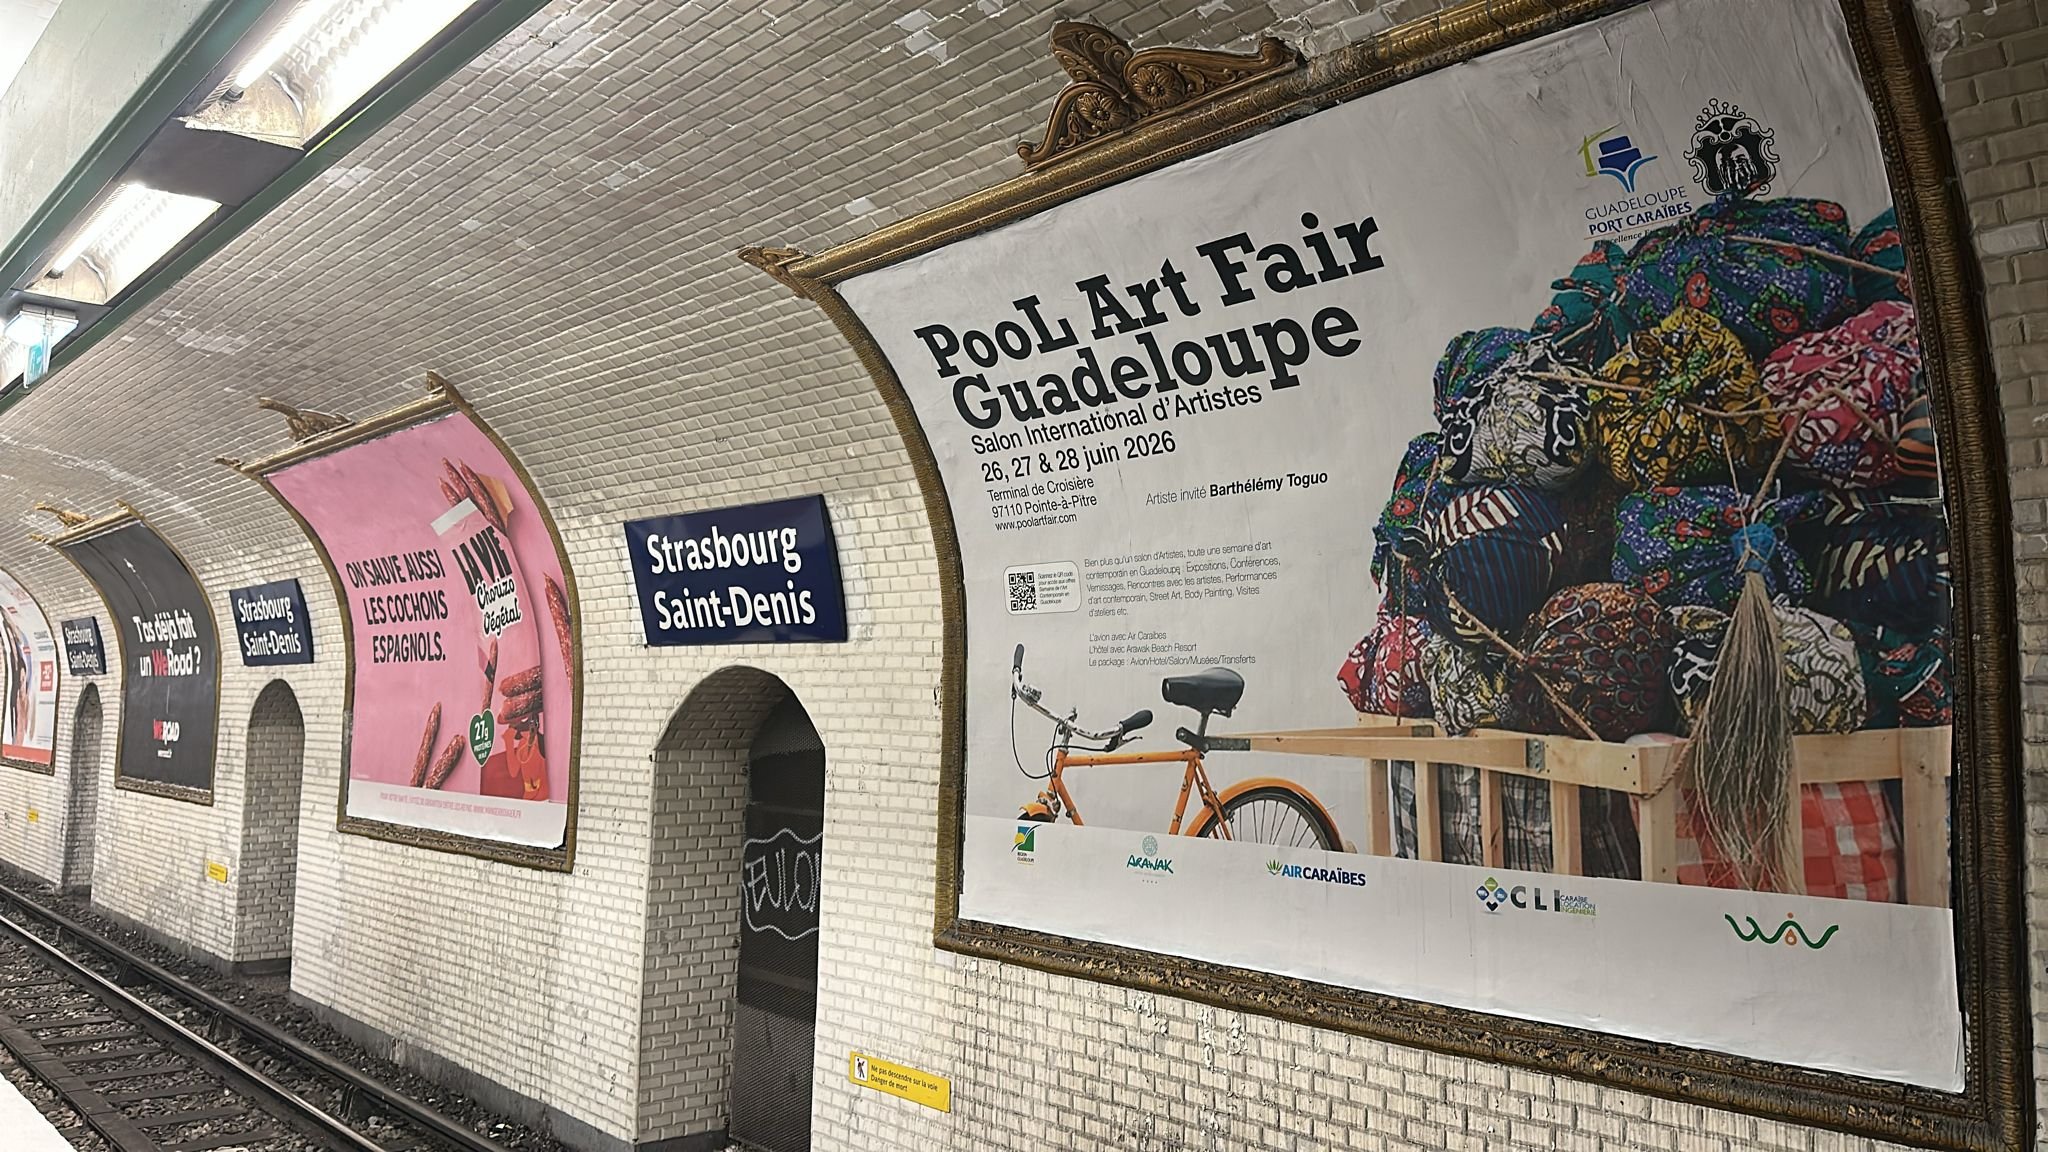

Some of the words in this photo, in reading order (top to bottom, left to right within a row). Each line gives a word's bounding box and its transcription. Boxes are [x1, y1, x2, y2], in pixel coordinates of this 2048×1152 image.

[1585, 186, 1687, 220] GUADELOUPE
[1588, 218, 1623, 235] PORT
[1626, 201, 1693, 226] CARAÏBES
[1611, 232, 1642, 244] cellence
[913, 294, 1080, 379] PooL
[1075, 257, 1201, 340] Art
[1195, 211, 1385, 307] Fair
[952, 306, 1362, 430] Guadeloupe
[971, 432, 1023, 455] Salon
[1024, 403, 1148, 446] International
[981, 461, 1009, 483] 26,
[1011, 455, 1033, 478] 27
[1039, 453, 1054, 474] &
[1055, 449, 1080, 470] 28
[1082, 442, 1120, 472] juin
[1124, 430, 1176, 460] 2026
[987, 484, 1030, 502] Terminal
[1031, 483, 1045, 496] de
[1046, 476, 1094, 494] Croisière
[1146, 489, 1177, 506] Artiste
[1180, 485, 1207, 501] invité
[1209, 477, 1284, 497] Barthélémy
[1286, 472, 1328, 489] Toguo
[991, 502, 1023, 518] 97110
[1024, 494, 1098, 514] Pointe-à-Pitre
[995, 513, 1078, 531] www.poolartfair.com
[646, 525, 802, 574] Strasbourg
[1100, 557, 1113, 566] plus
[1134, 552, 1152, 562] salon
[1187, 548, 1205, 557] toute
[1207, 547, 1221, 555] une
[1222, 544, 1253, 554] semaine
[345, 561, 368, 588] ON
[362, 555, 407, 586] SAUVE
[403, 548, 446, 582] AUSSI
[1085, 568, 1128, 580] contemporain
[1129, 569, 1138, 577] en
[1127, 580, 1165, 589] Rencontres
[1166, 579, 1183, 587] avec
[1184, 577, 1195, 585] les
[1225, 571, 1278, 582] Performances
[362, 596, 387, 625] LES
[387, 589, 448, 623] COCHONS
[477, 578, 515, 610] Chorizo
[653, 579, 816, 631] Saint-Denis
[1149, 591, 1170, 601] Street
[1184, 589, 1203, 599] Body
[1236, 586, 1260, 595] Visites
[237, 594, 294, 624] Strasbourg
[483, 597, 521, 636] Végétal
[1116, 607, 1128, 616] etc.
[154, 611, 178, 649] déjà
[174, 608, 197, 639] fait
[243, 627, 302, 657] Saint-Denis
[1111, 633, 1127, 641] avec
[1127, 632, 1136, 641] Air
[140, 655, 152, 677] un
[151, 646, 193, 677] WeRoad
[373, 631, 446, 664] ESPAGNOLS.
[1088, 657, 1097, 667] Le
[1098, 657, 1125, 668] package
[1110, 645, 1125, 653] avec
[1126, 644, 1150, 653] Arawak
[1151, 643, 1173, 652] Beach
[1174, 643, 1197, 652] Resort
[1127, 854, 1174, 874] ARAWAK
[870, 1064, 878, 1073] Ne
[878, 1067, 888, 1076] pas
[888, 1070, 912, 1084] descendre
[921, 1079, 927, 1088] la
[927, 1082, 938, 1092] voie
[870, 1074, 888, 1086] Danger
[888, 1080, 895, 1088] de
[895, 1083, 908, 1092] mort
